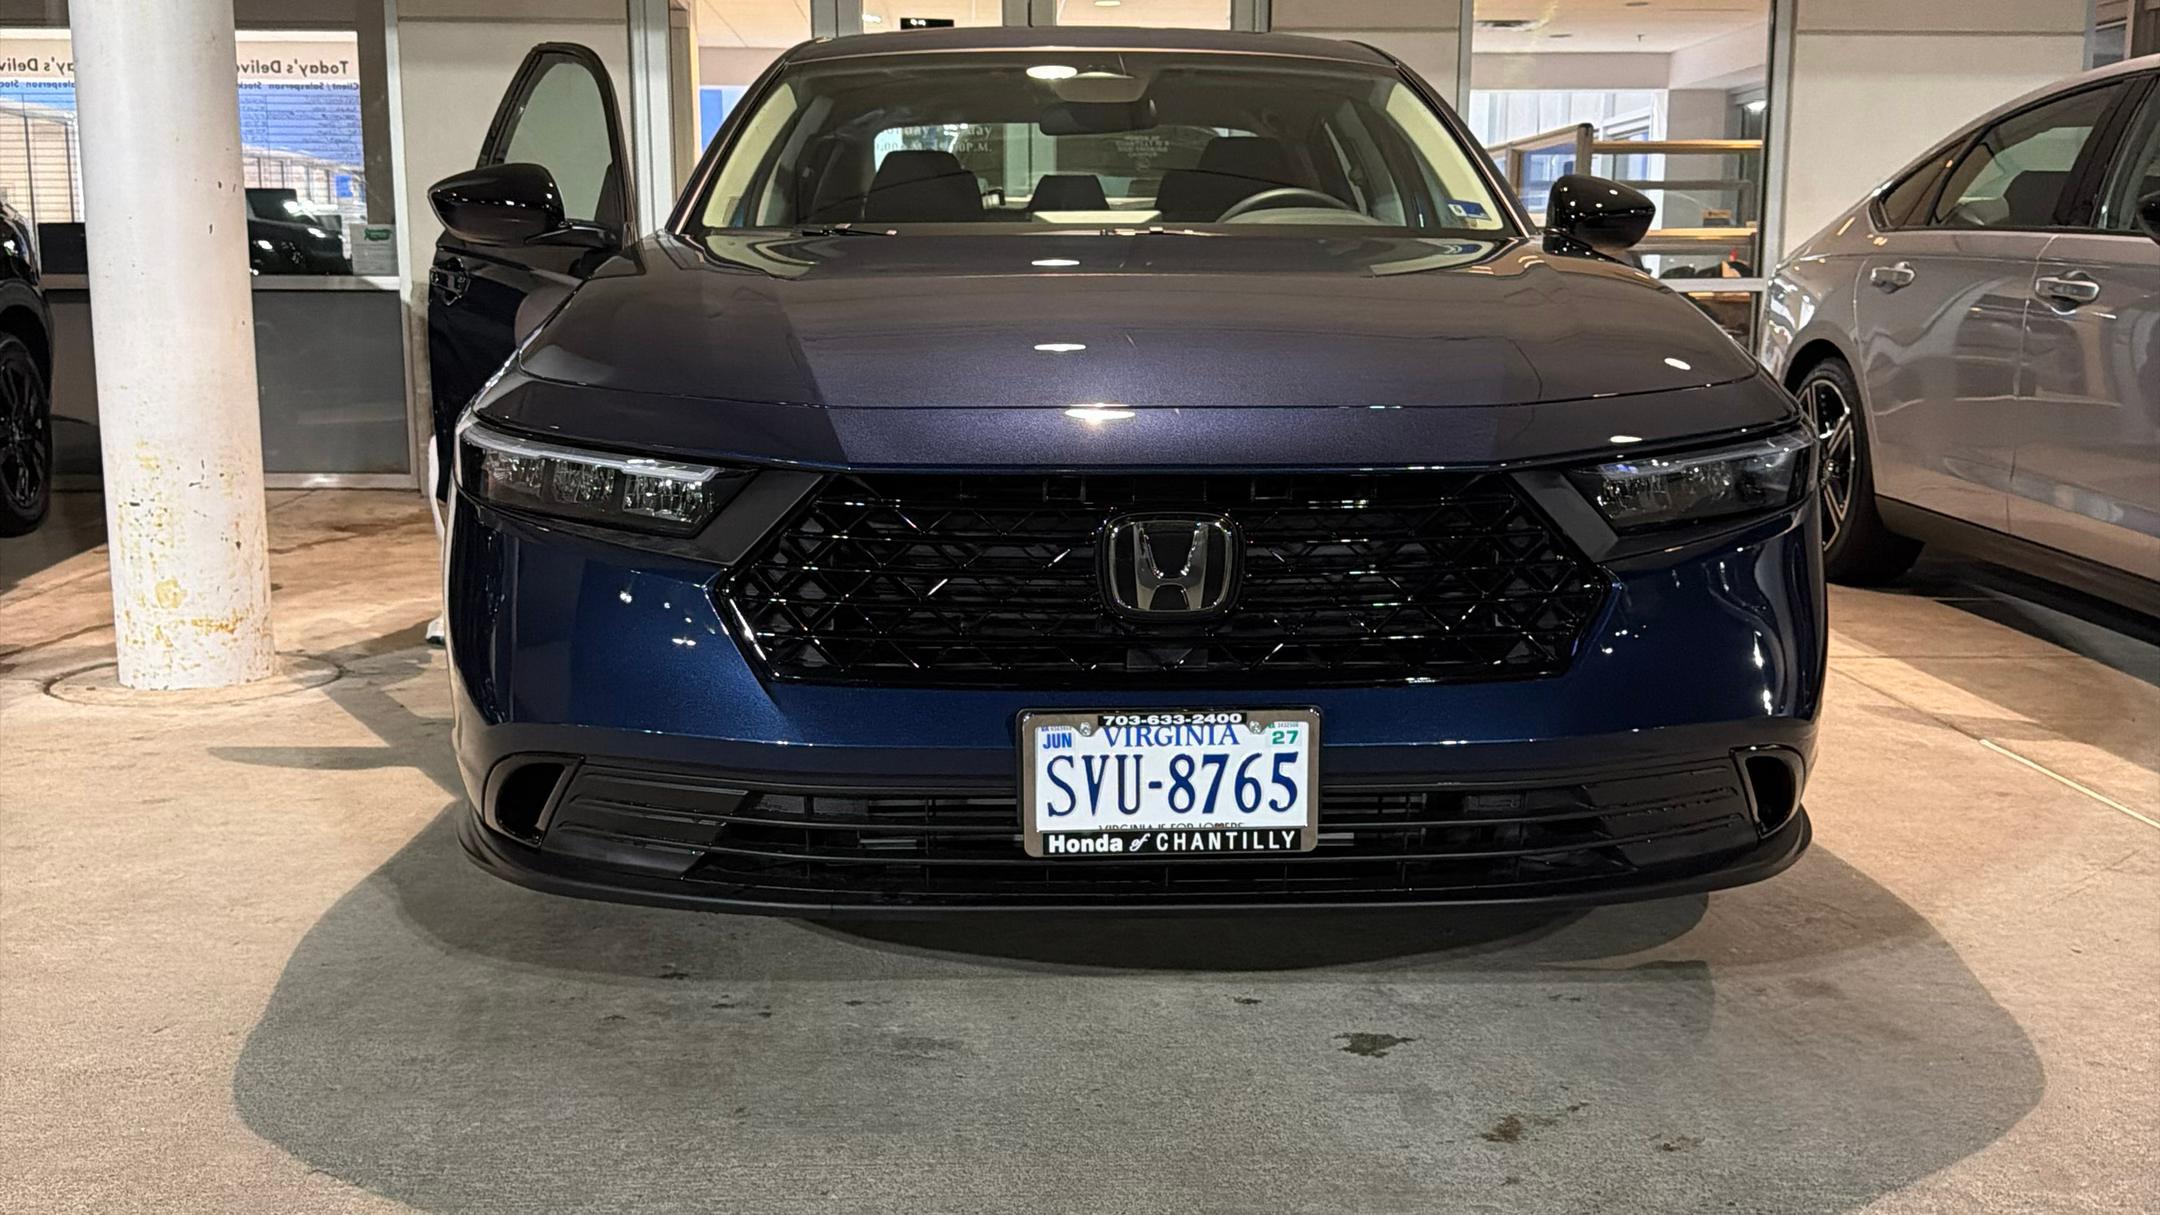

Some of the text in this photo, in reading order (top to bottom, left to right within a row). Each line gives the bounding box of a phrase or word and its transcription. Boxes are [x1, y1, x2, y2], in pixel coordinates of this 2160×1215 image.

[1103, 713, 1242, 726] 703-633-2400
[1042, 732, 1072, 749] JUN
[1104, 724, 1241, 748] VIRGINIA
[1272, 730, 1299, 745] 27
[1047, 752, 1299, 817] SVU-8765
[1049, 831, 1296, 853] Honda of CHANTILLY
